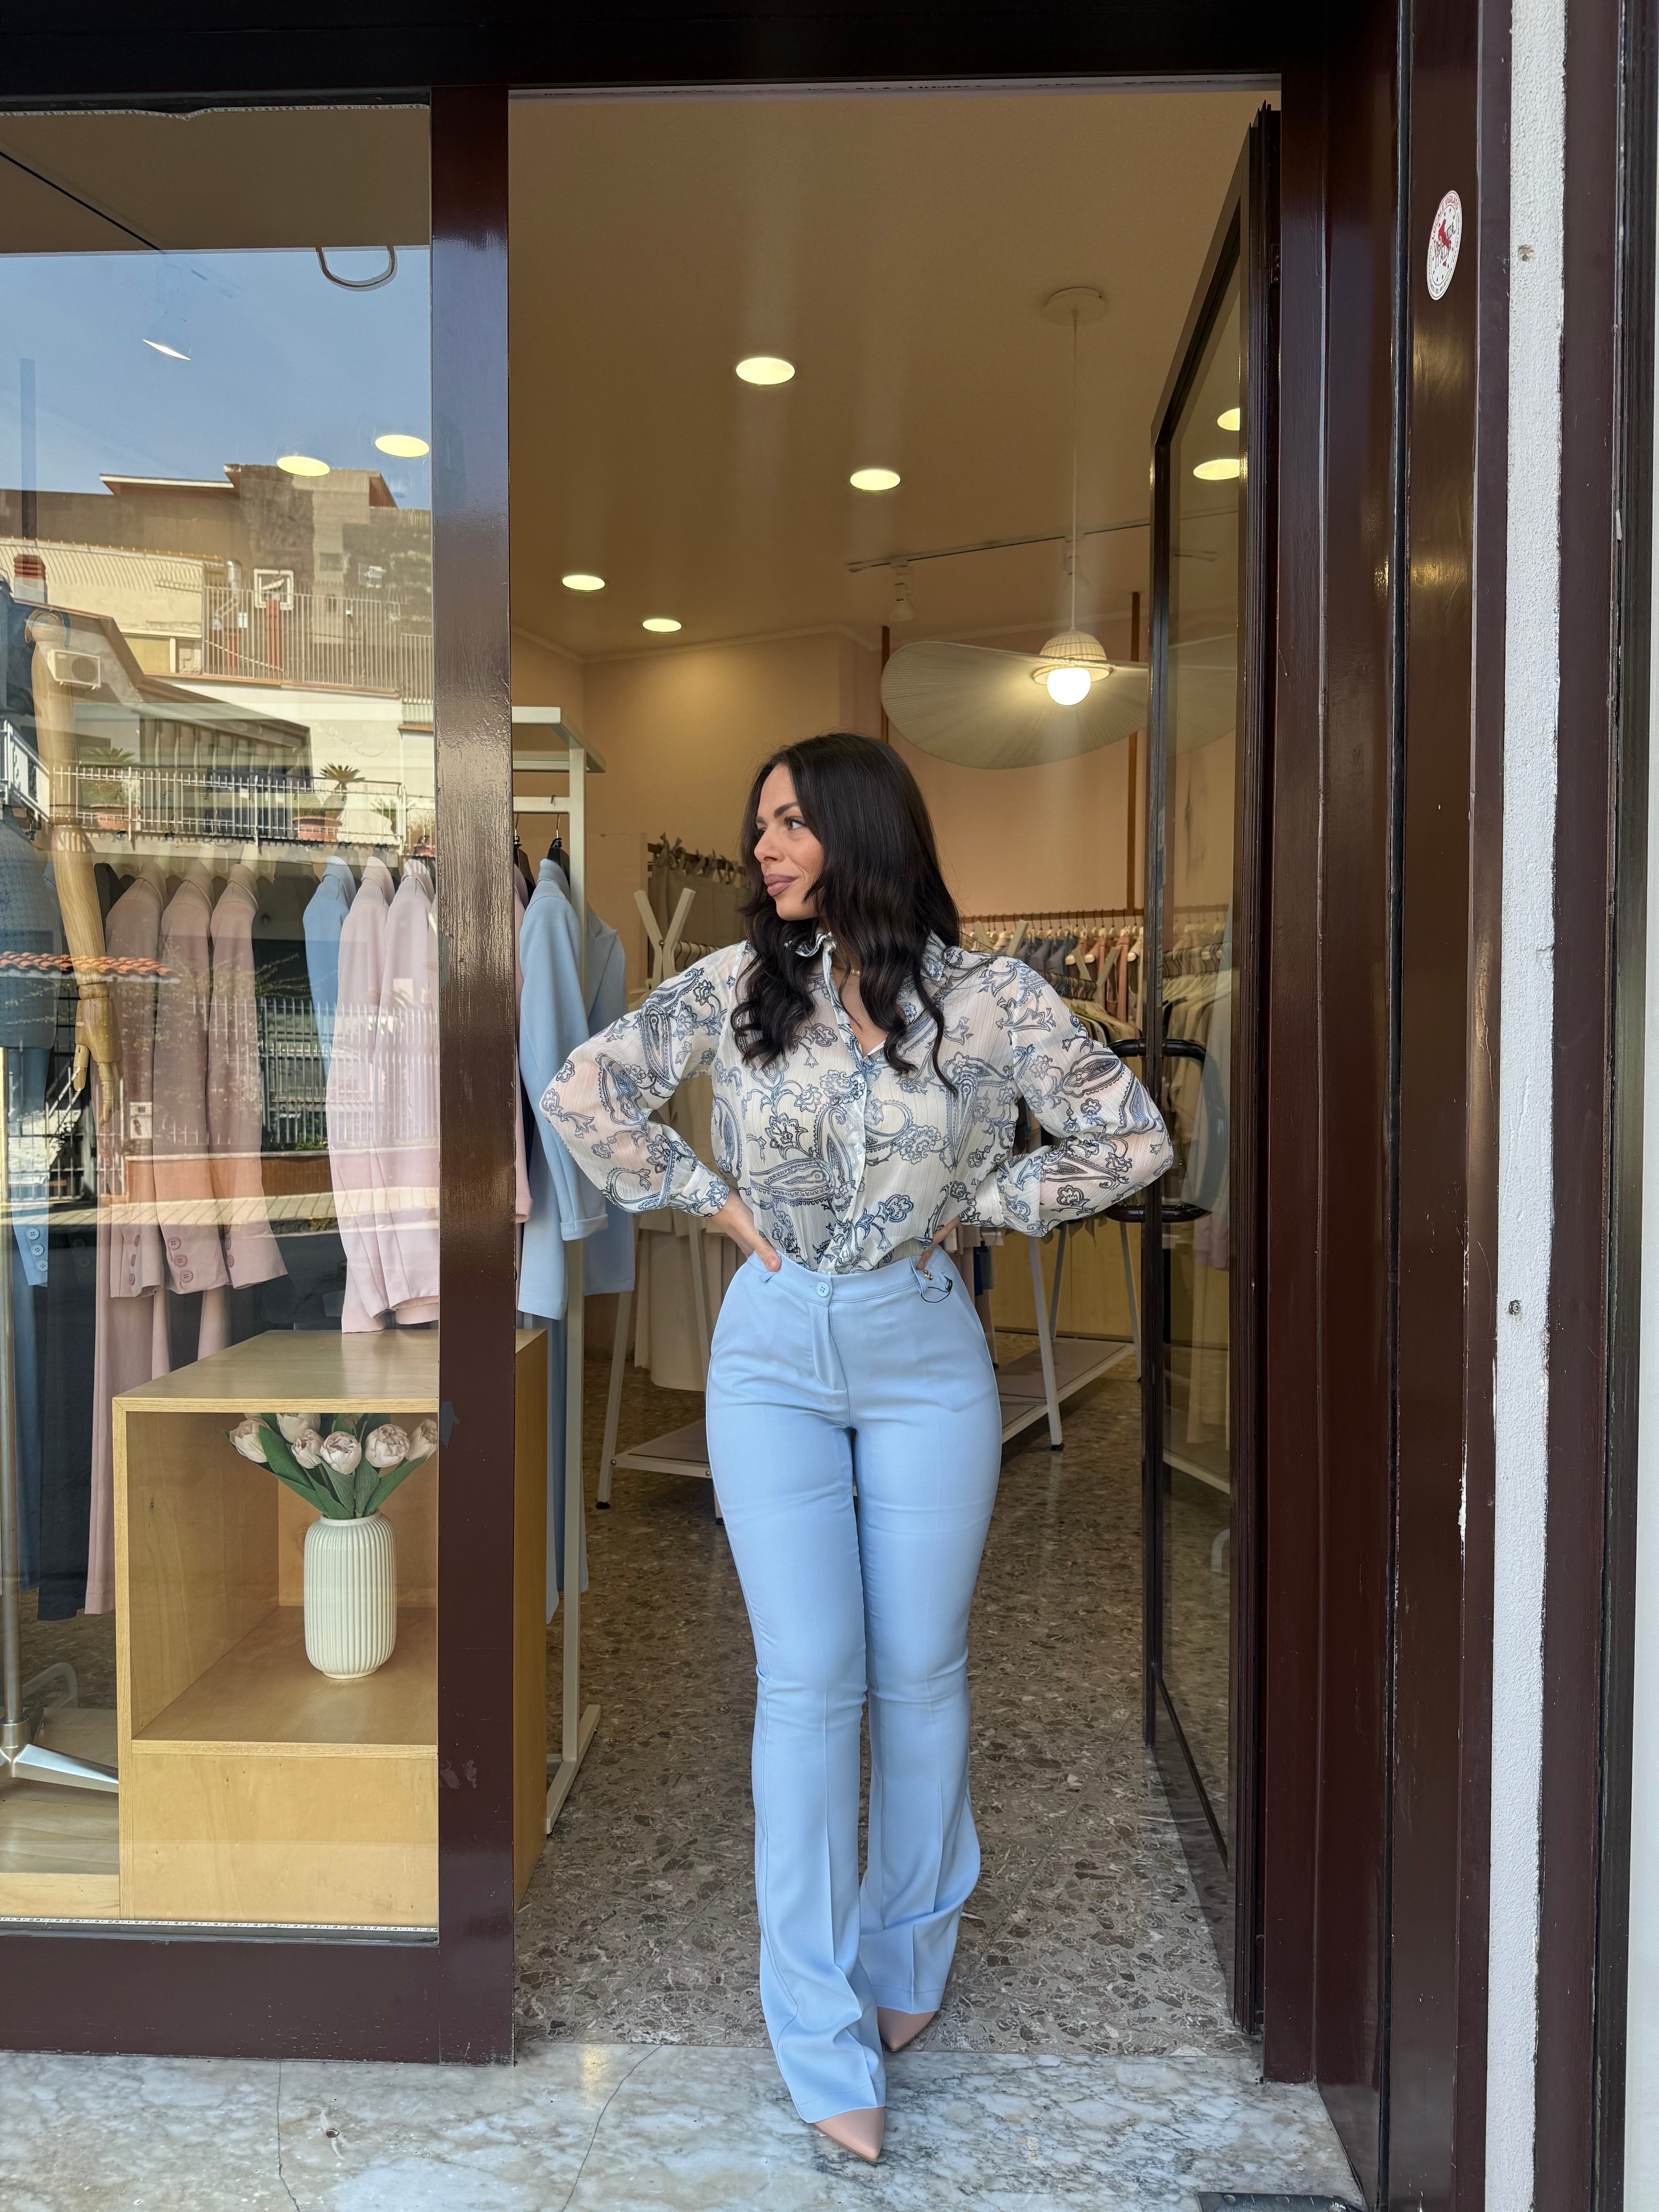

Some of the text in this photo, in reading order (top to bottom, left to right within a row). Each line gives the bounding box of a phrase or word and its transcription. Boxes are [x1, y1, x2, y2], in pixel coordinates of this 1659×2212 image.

[1432, 195, 1459, 240] LOCALE VIGILATO
[1434, 222, 1454, 257] VIGILZA
